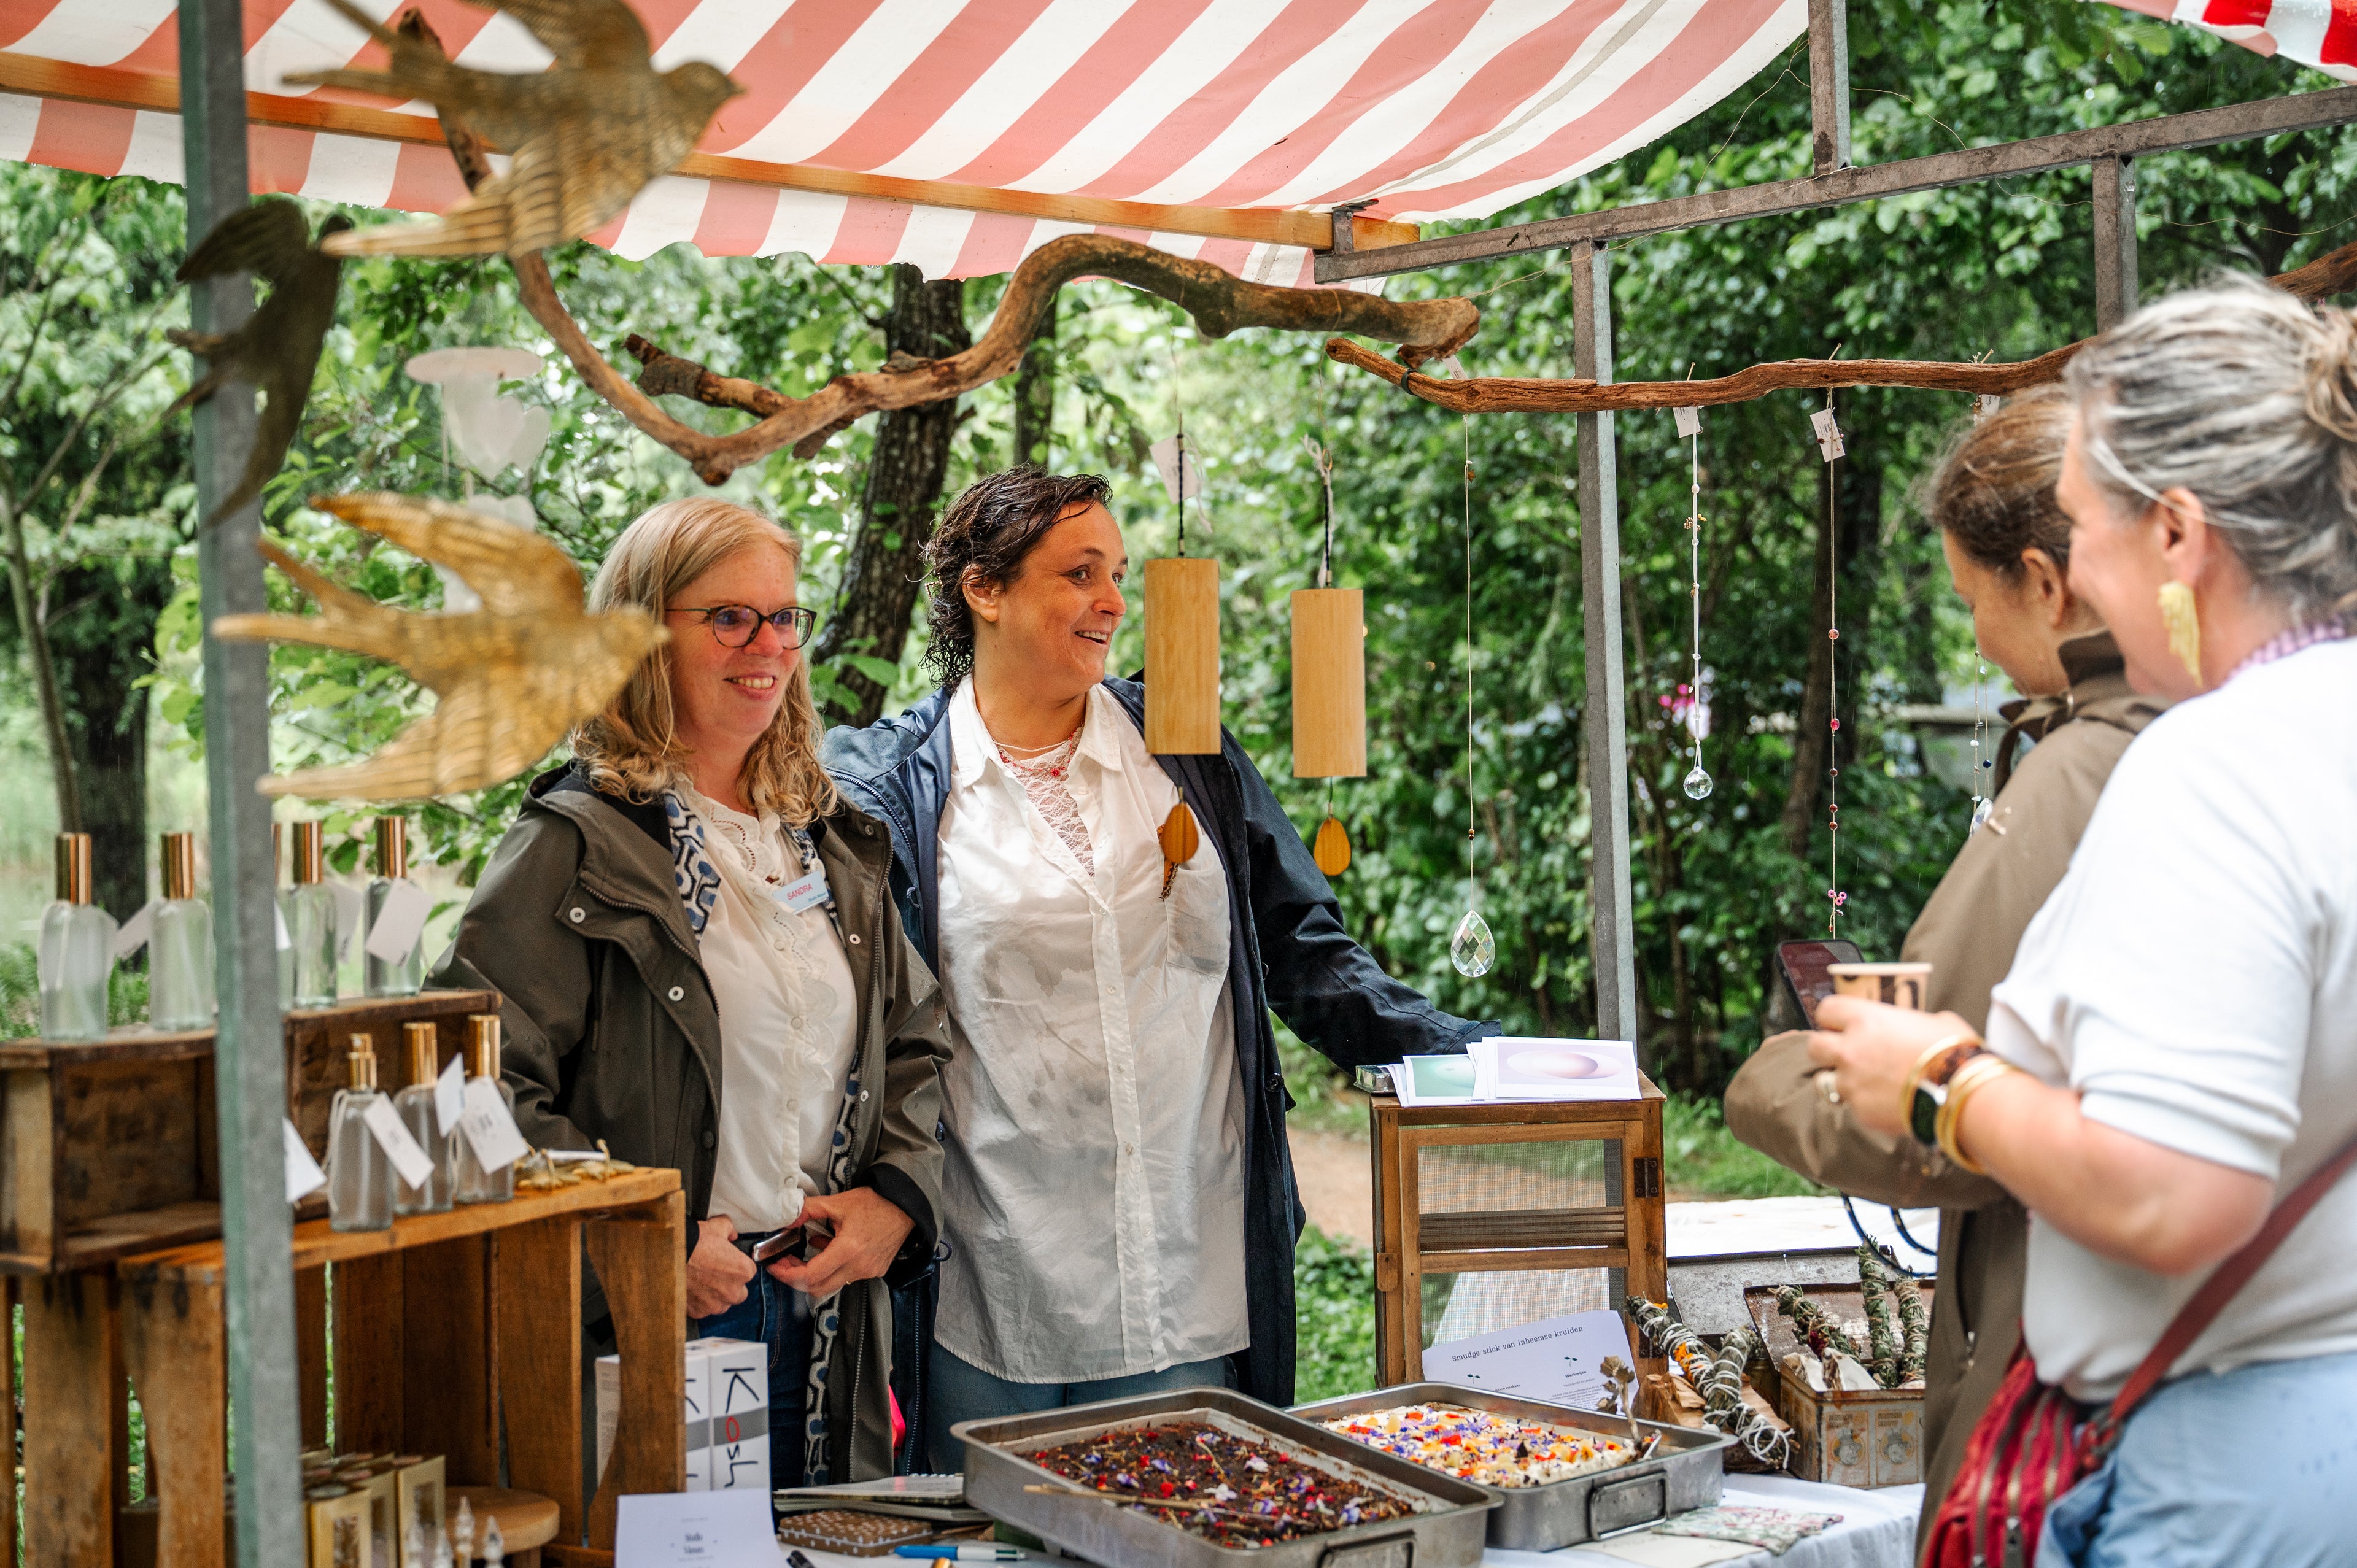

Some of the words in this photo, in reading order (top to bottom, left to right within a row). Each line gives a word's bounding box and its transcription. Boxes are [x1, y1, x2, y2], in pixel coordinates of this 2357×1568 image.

[787, 883, 813, 900] SANDRA
[1452, 1350, 1480, 1362] Smudge
[1482, 1344, 1501, 1354] stick
[1518, 1332, 1552, 1346] inheemse
[1554, 1326, 1583, 1337] kruiden
